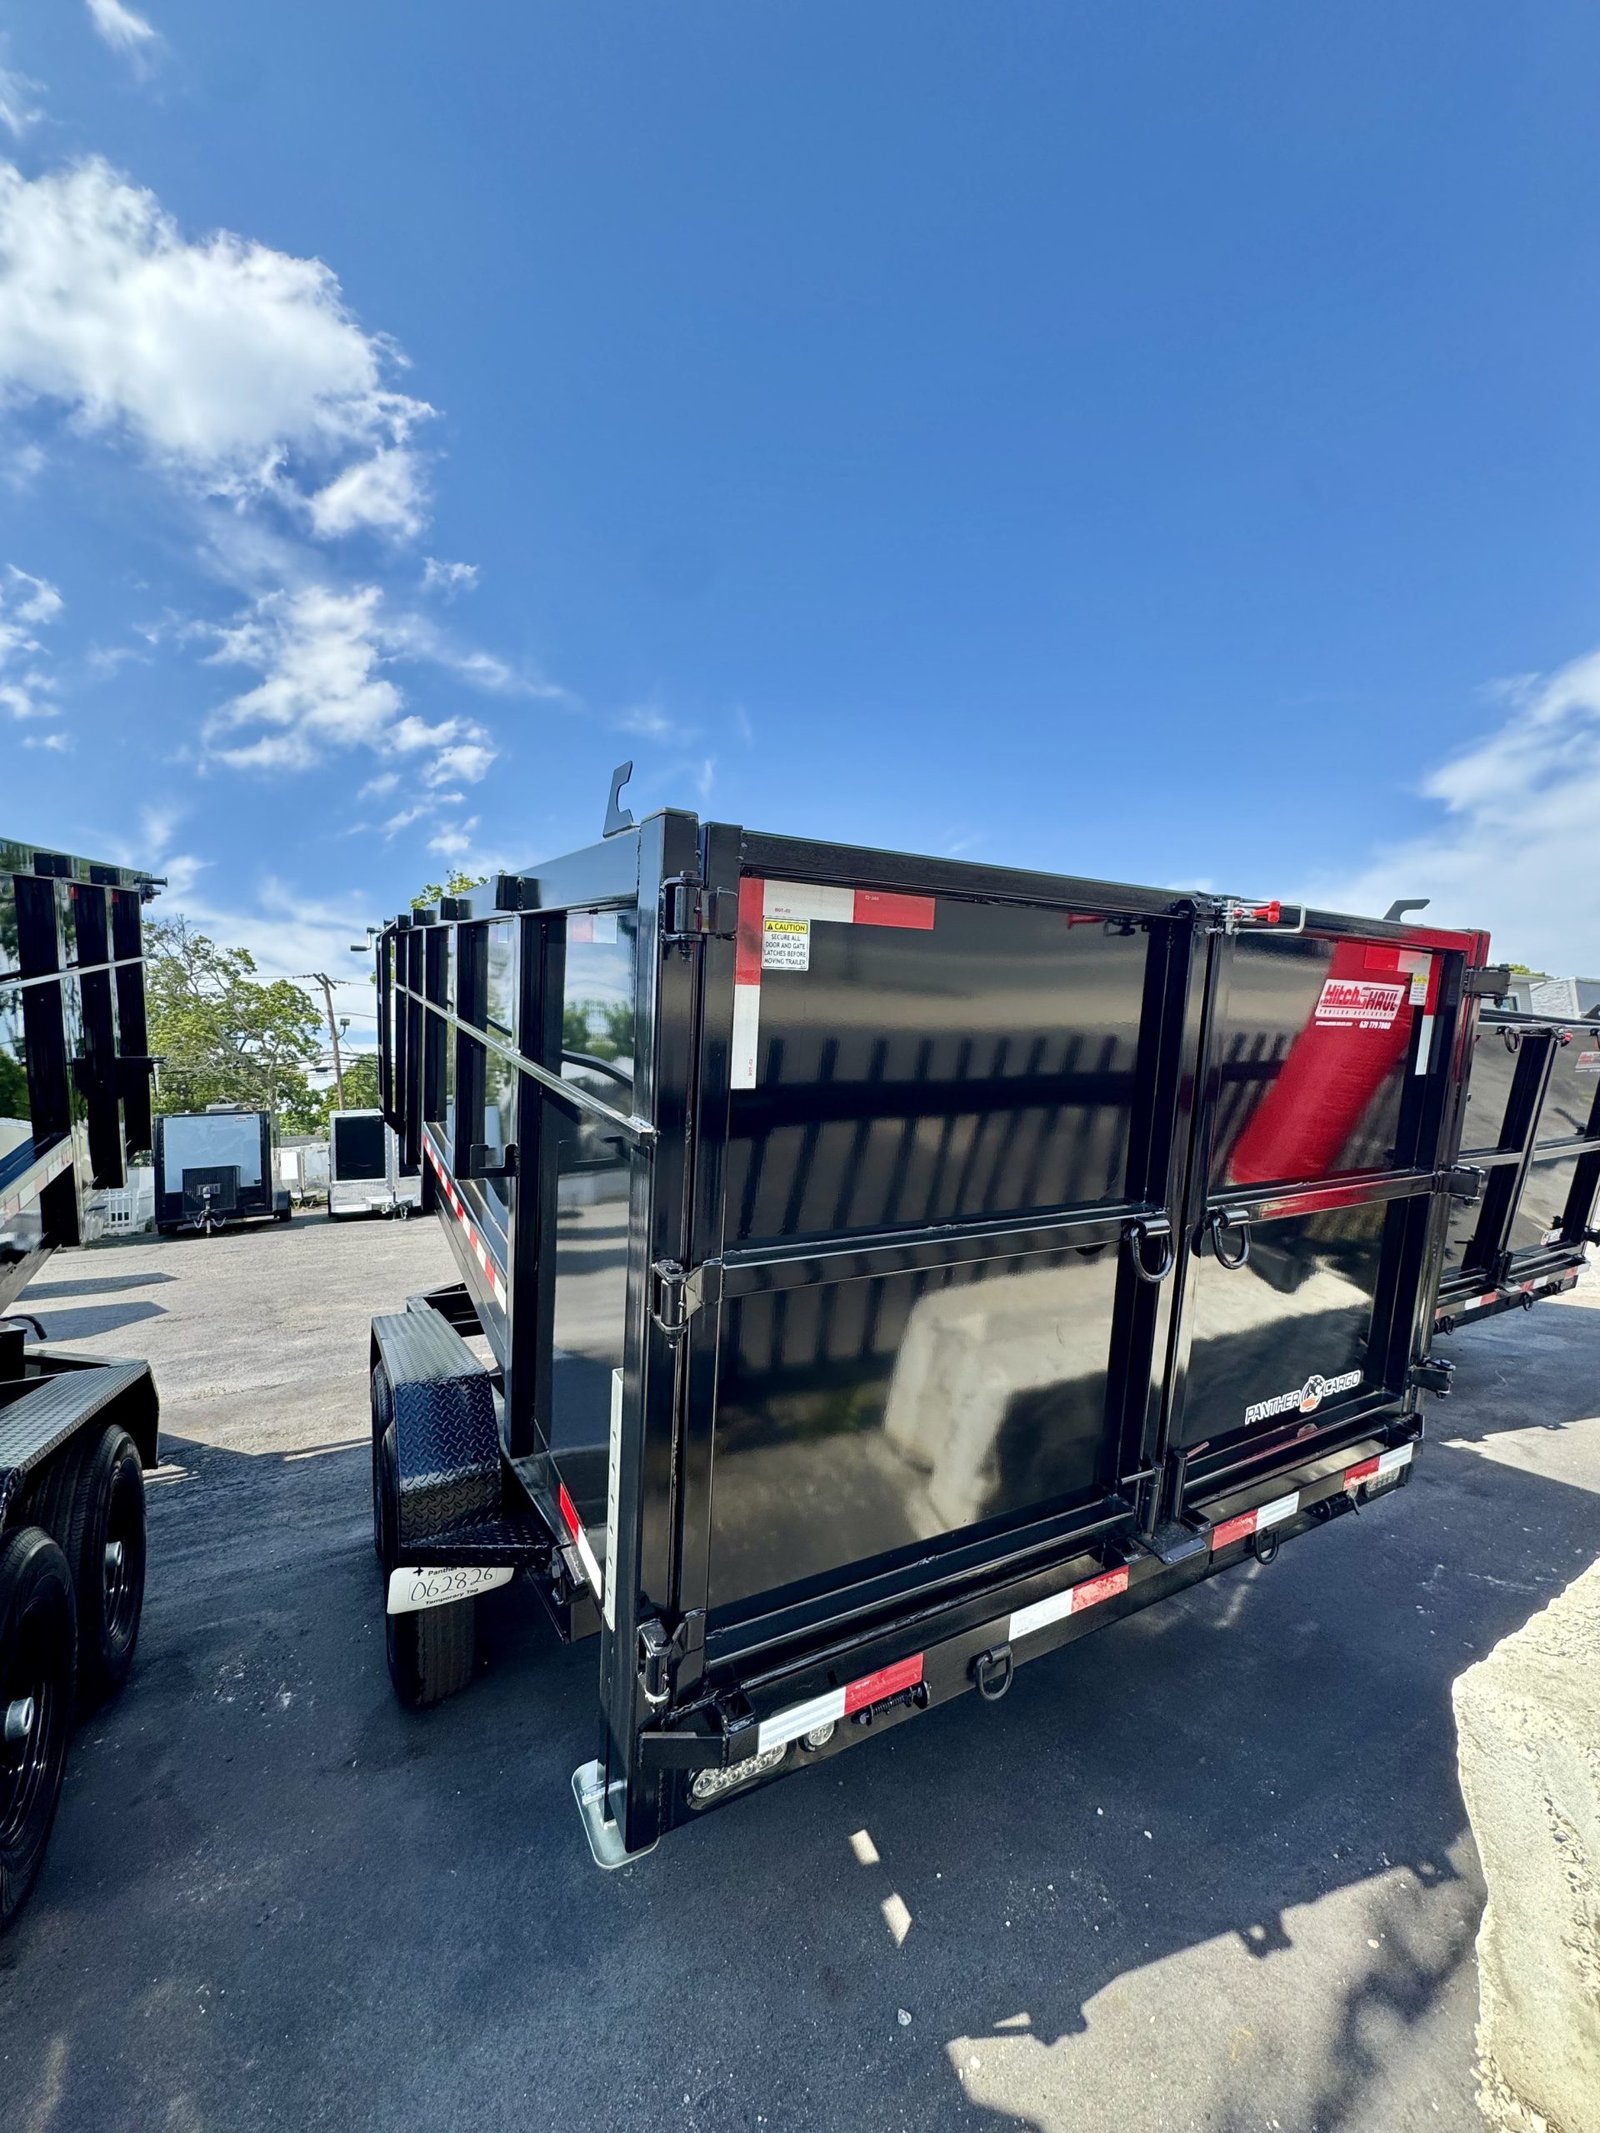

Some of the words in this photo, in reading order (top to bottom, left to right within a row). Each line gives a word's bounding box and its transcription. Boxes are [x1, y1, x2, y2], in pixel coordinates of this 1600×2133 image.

[774, 923, 806, 932] CAUTION
[764, 949, 786, 957] LATCHES
[764, 957, 785, 965] MOVING
[785, 958, 806, 966] TRAILER
[1323, 983, 1361, 1006] Hitch
[1365, 990, 1399, 1012] HAUL
[1245, 1390, 1301, 1425] PANTHER
[1322, 1369, 1362, 1397] CARGO
[425, 1591, 465, 1605] Temporary
